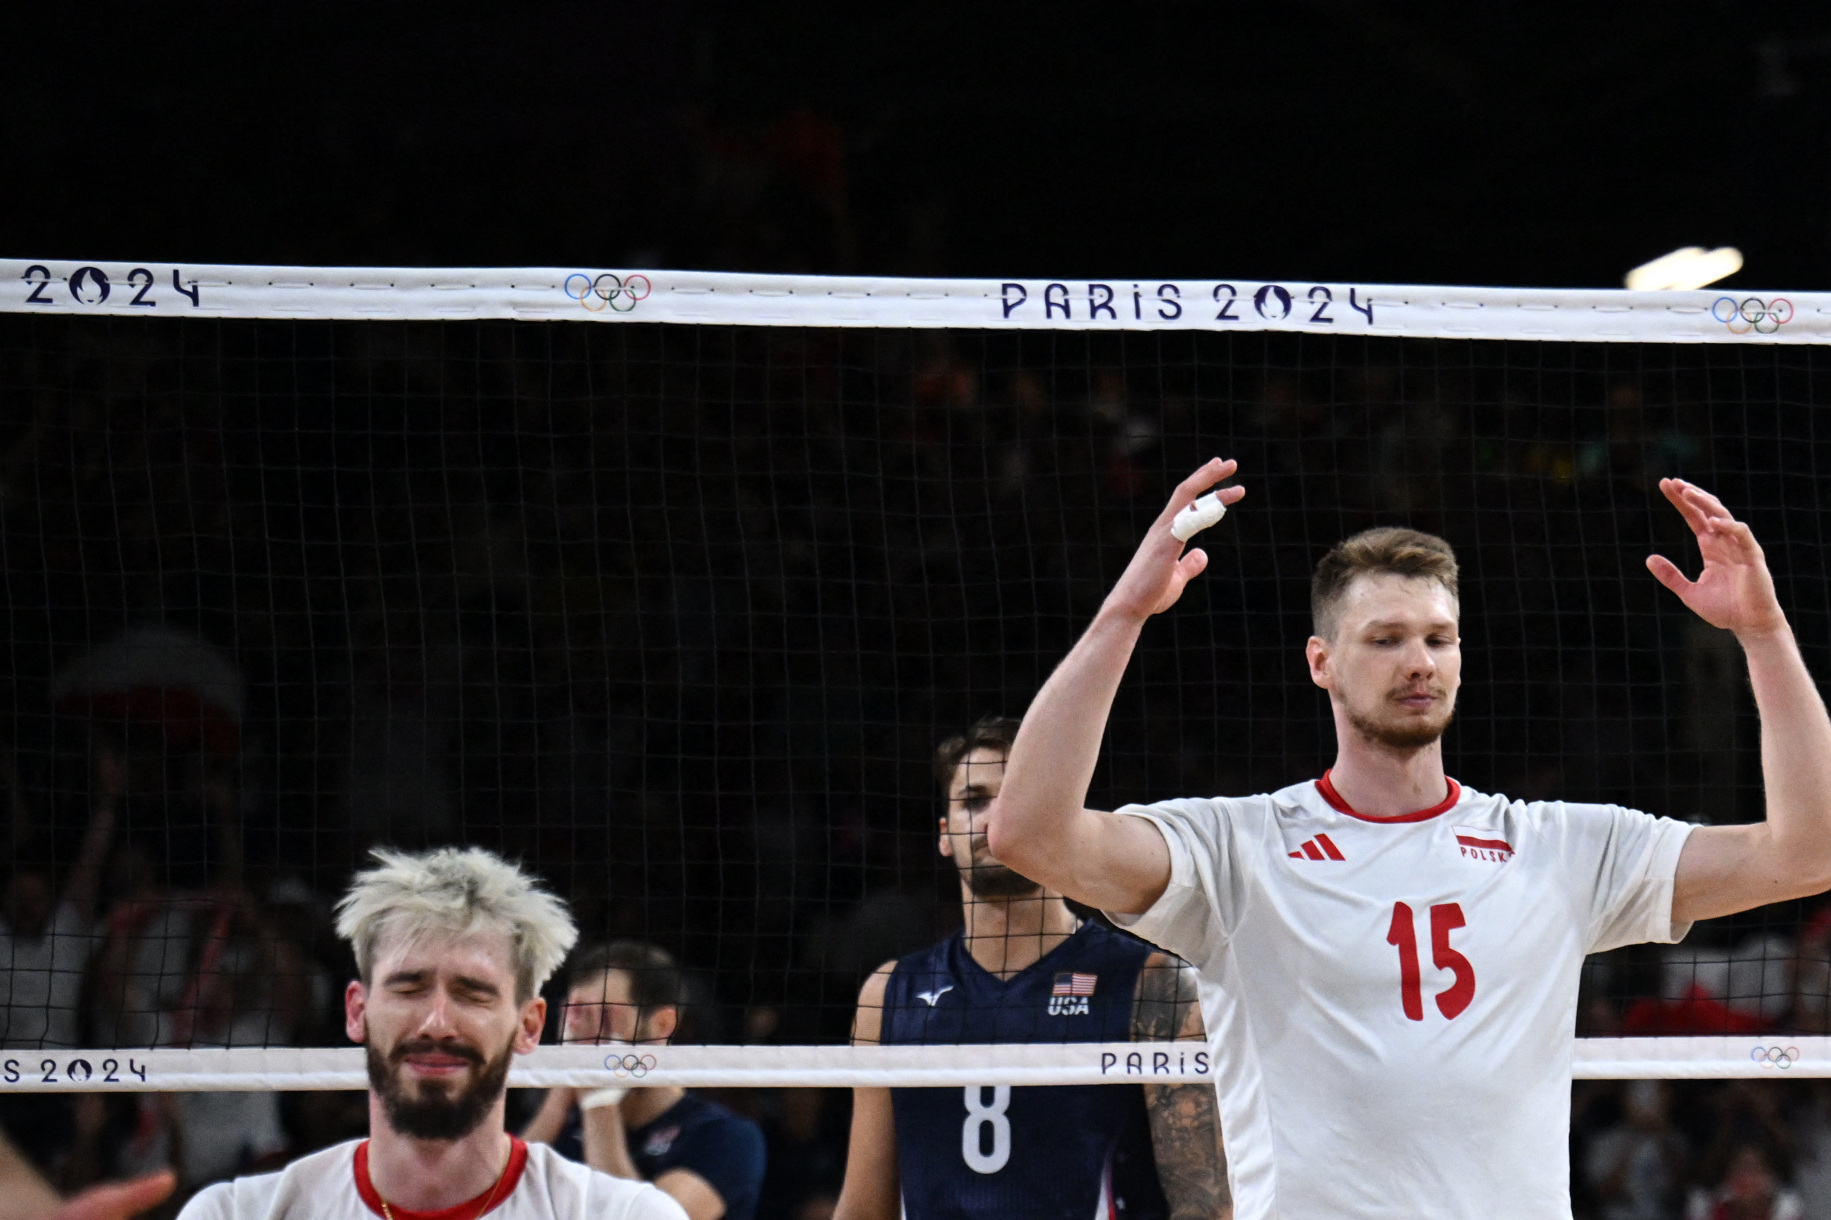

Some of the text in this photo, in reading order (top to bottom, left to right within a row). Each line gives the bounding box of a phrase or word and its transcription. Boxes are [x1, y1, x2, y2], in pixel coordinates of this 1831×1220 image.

[1047, 995, 1090, 1016] USA
[1388, 902, 1475, 1020] 15
[962, 1085, 1011, 1175] 8
